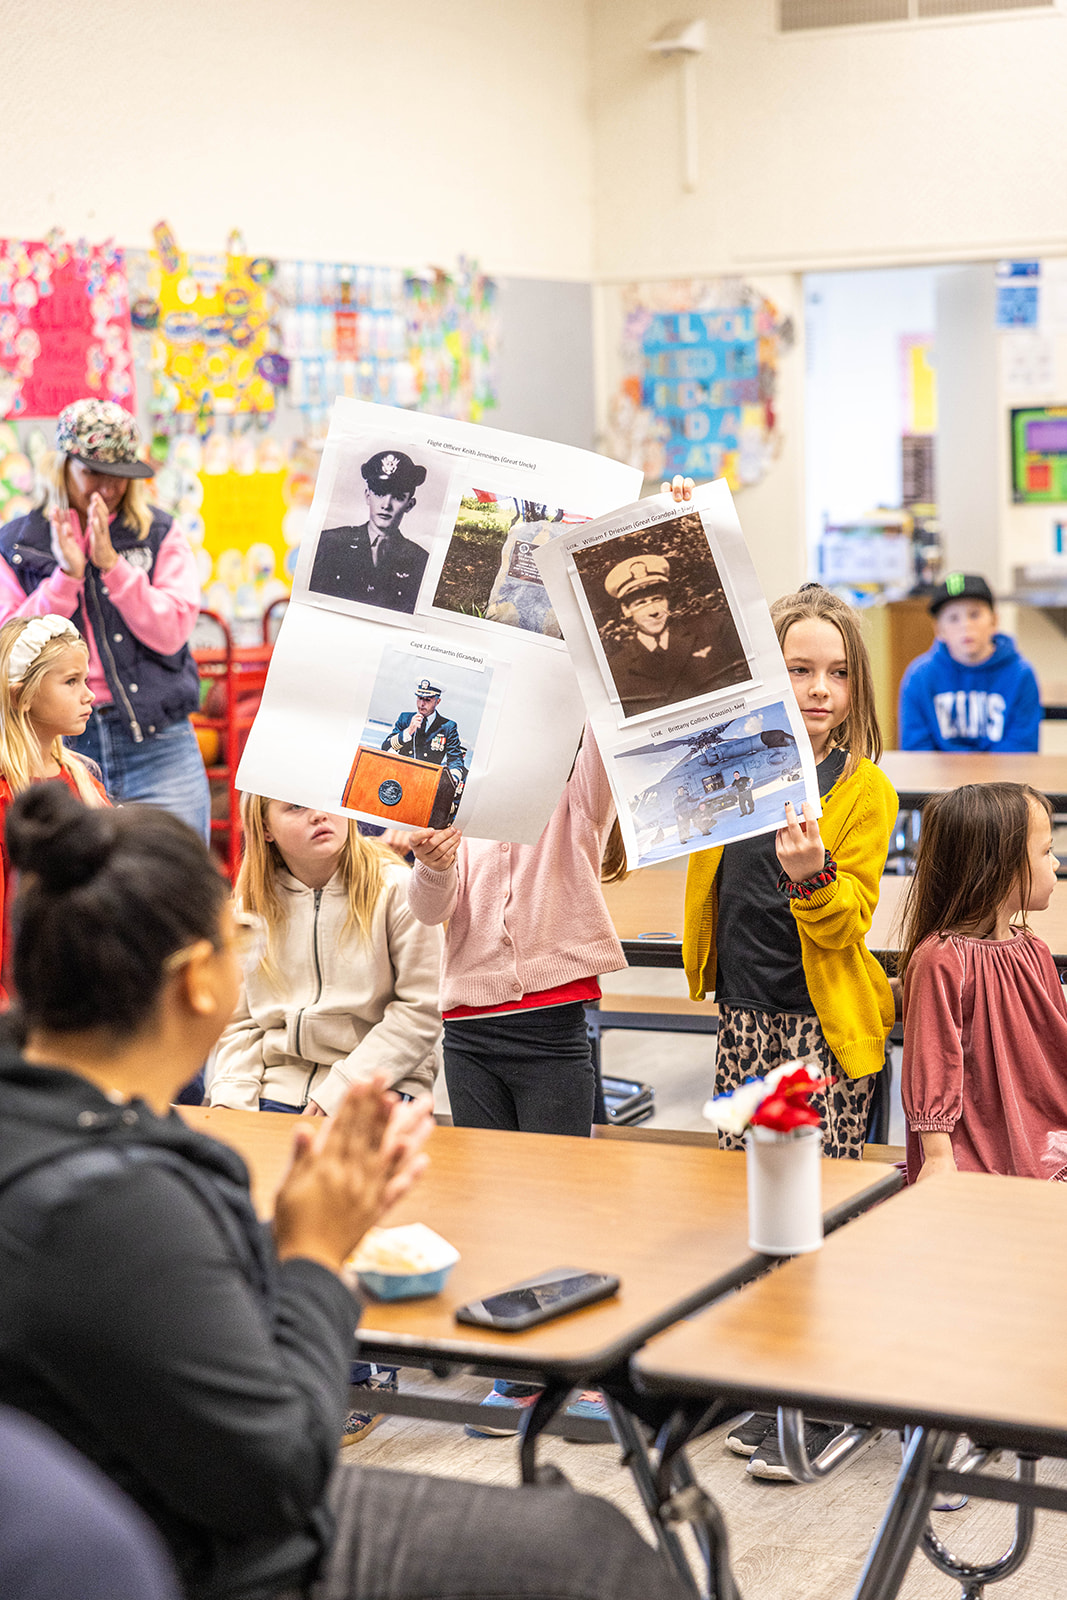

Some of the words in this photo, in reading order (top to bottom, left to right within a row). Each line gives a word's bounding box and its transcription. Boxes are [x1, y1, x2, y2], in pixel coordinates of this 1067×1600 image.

[427, 438, 442, 447] Flight
[443, 442, 461, 452] Officer
[462, 446, 476, 456] Keith
[477, 451, 500, 461] Jennings
[500, 456, 518, 465] (Great
[519, 461, 537, 470] Uncle)
[582, 534, 604, 545] William
[608, 524, 632, 535] Driessen
[633, 516, 651, 528] (Great
[651, 509, 677, 522] Grandpa)
[410, 640, 423, 649] Capt
[431, 646, 456, 657] Gilmartin
[456, 652, 483, 664] (Grandpa)
[668, 722, 690, 733] Brittany
[690, 716, 708, 726] Collins
[709, 707, 731, 719] (Cousin)
